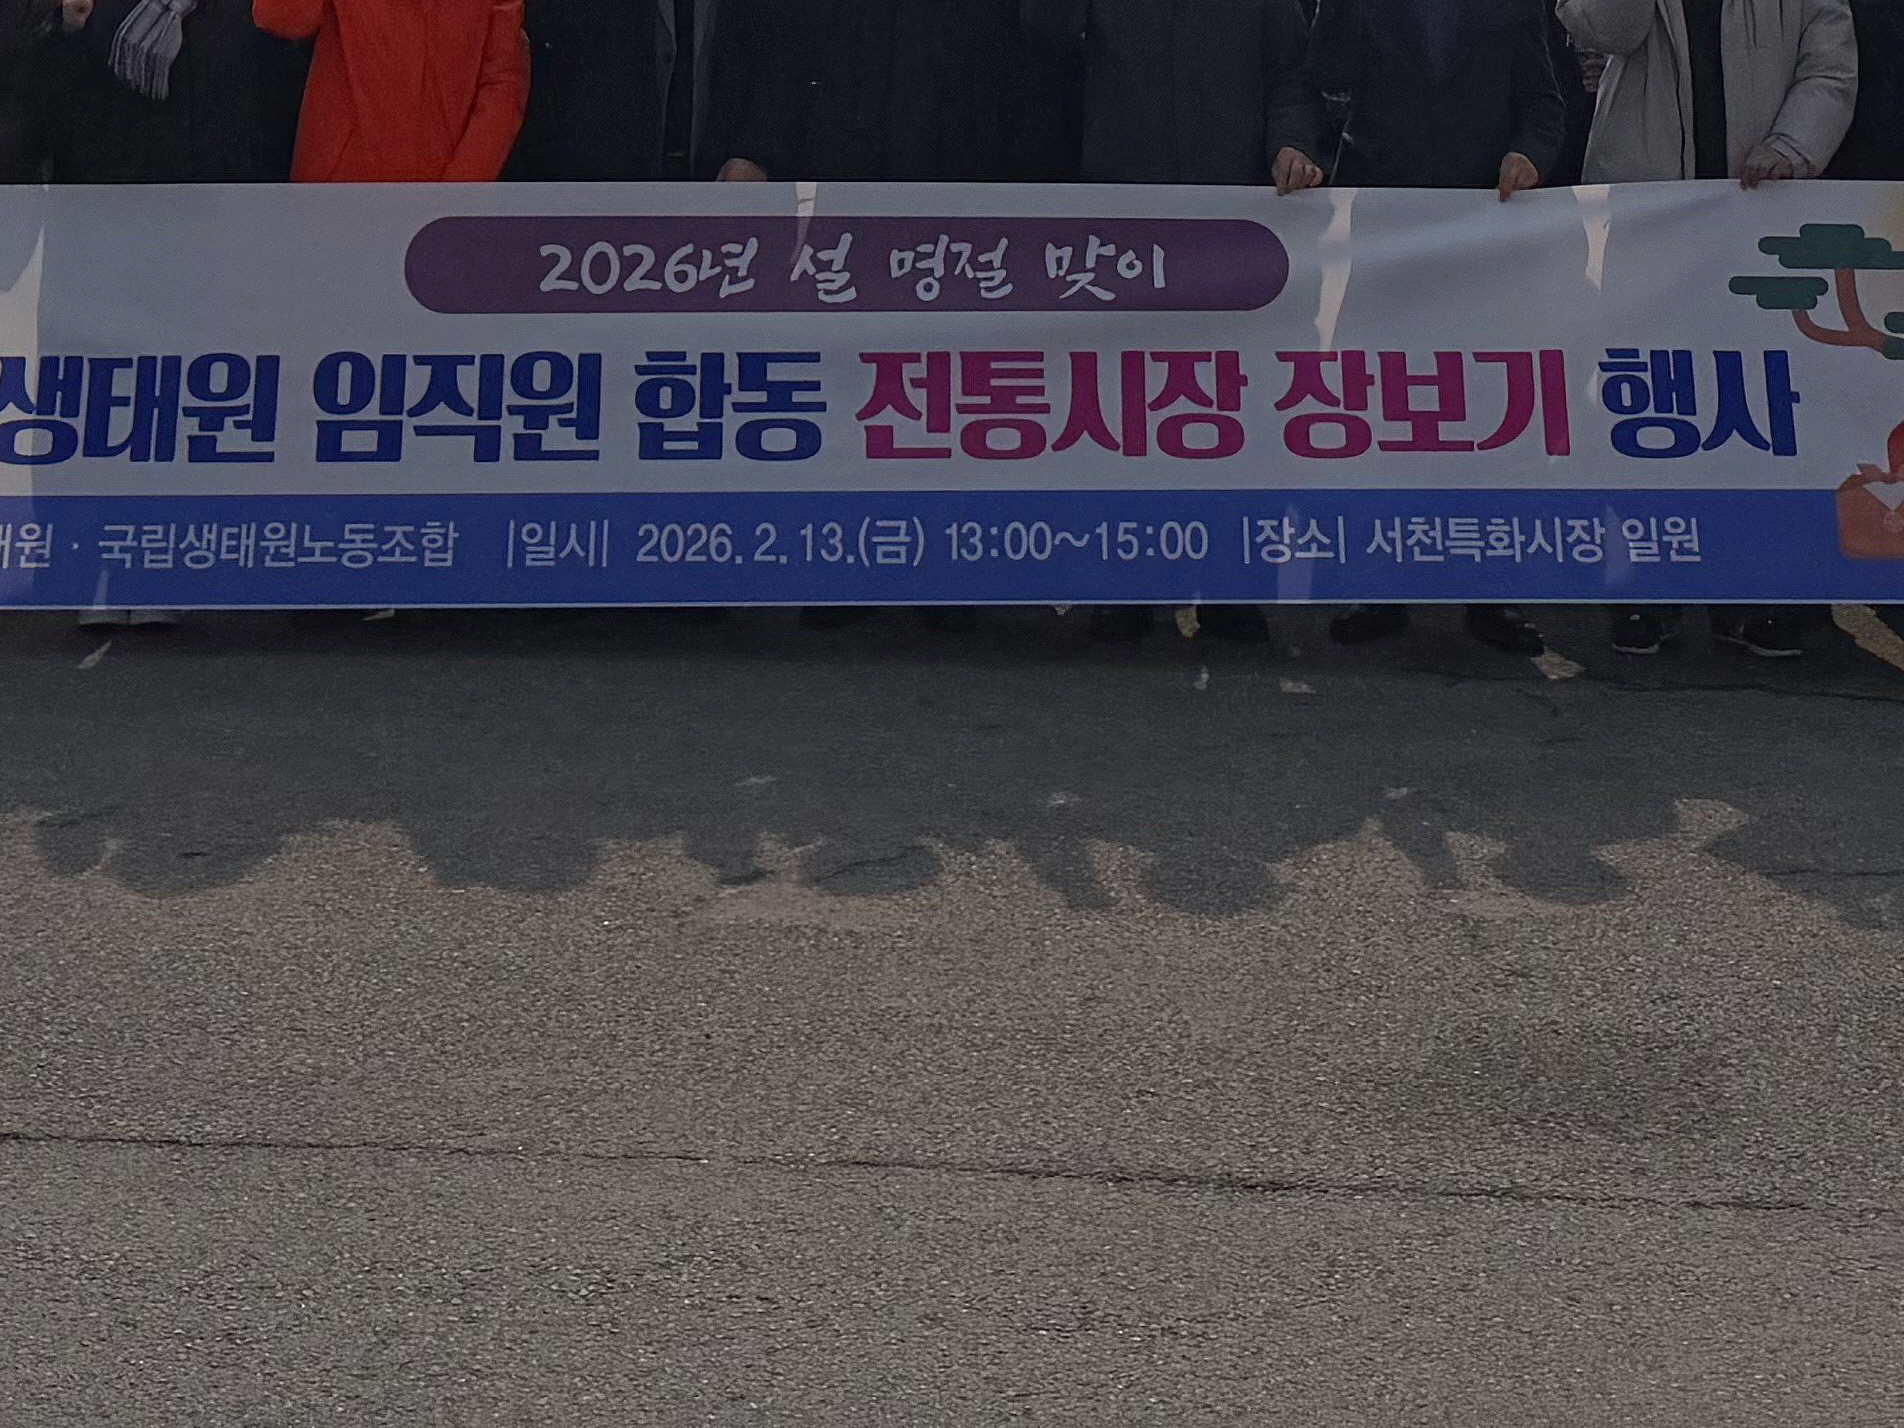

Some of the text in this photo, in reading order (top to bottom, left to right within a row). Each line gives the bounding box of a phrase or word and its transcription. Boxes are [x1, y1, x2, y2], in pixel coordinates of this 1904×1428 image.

[538, 234, 1168, 304] 2026년 설 명절 맞이
[313, 351, 602, 463] 임직원
[632, 350, 828, 460] 합동
[854, 349, 1247, 460] 전통시장
[1273, 348, 1572, 458] 장보기
[1596, 346, 1801, 458] 행사
[97, 521, 459, 569] 국립생태원노동조합
[945, 520, 1209, 563] 13:00~15:00
[1366, 515, 1606, 564] 서천특화시장
[1621, 515, 1702, 563] 일원
